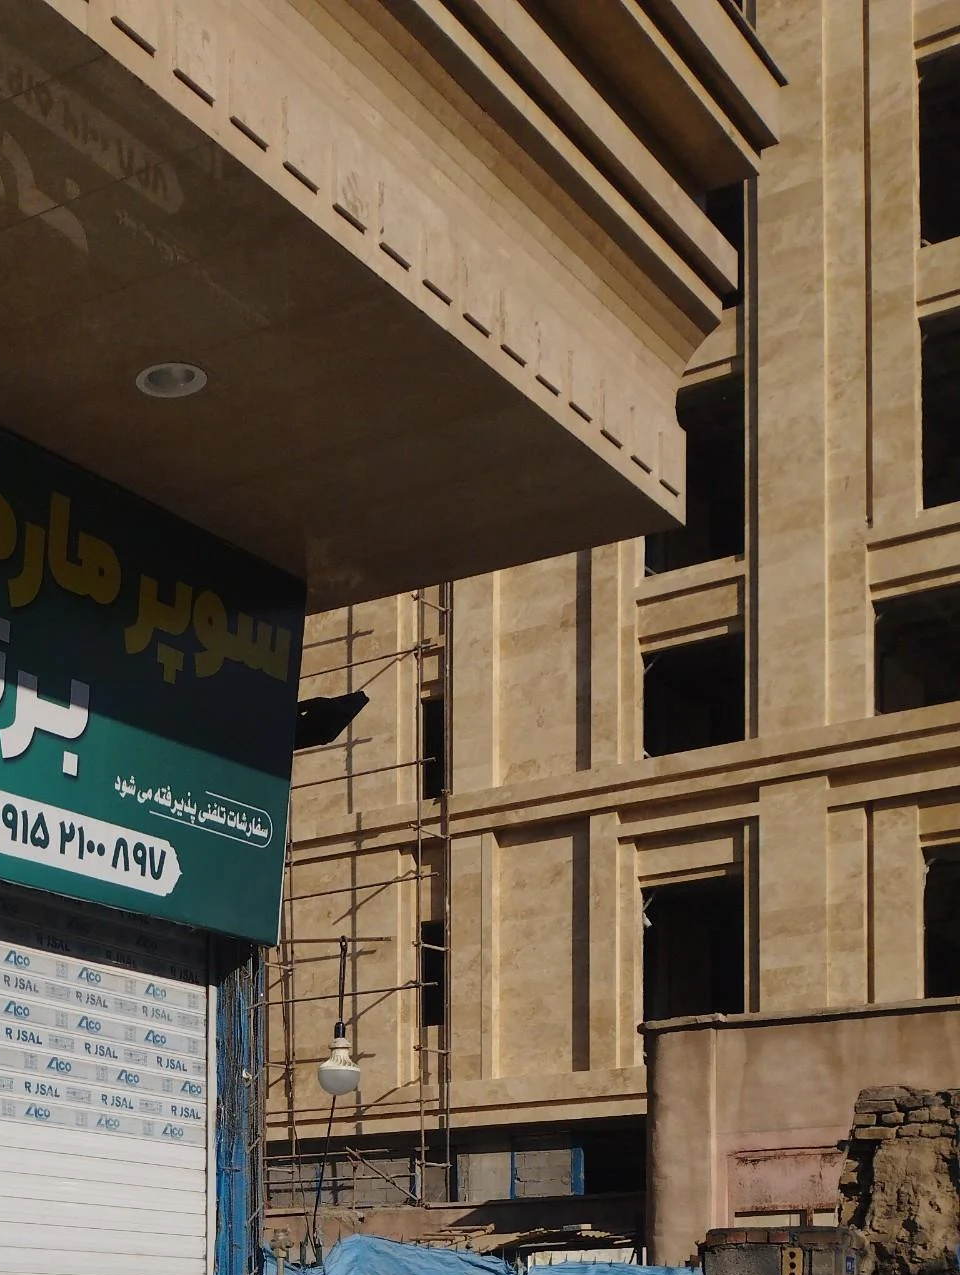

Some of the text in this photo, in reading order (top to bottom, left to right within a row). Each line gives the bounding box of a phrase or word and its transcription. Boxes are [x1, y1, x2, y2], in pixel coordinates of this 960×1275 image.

[124, 573, 291, 684] سوپر
[114, 775, 268, 838] سفارشات تلفنی پذیرفته می شود
[59, 820, 106, 860] ۲۱۰۰
[111, 837, 167, 880] ۸۹۷
